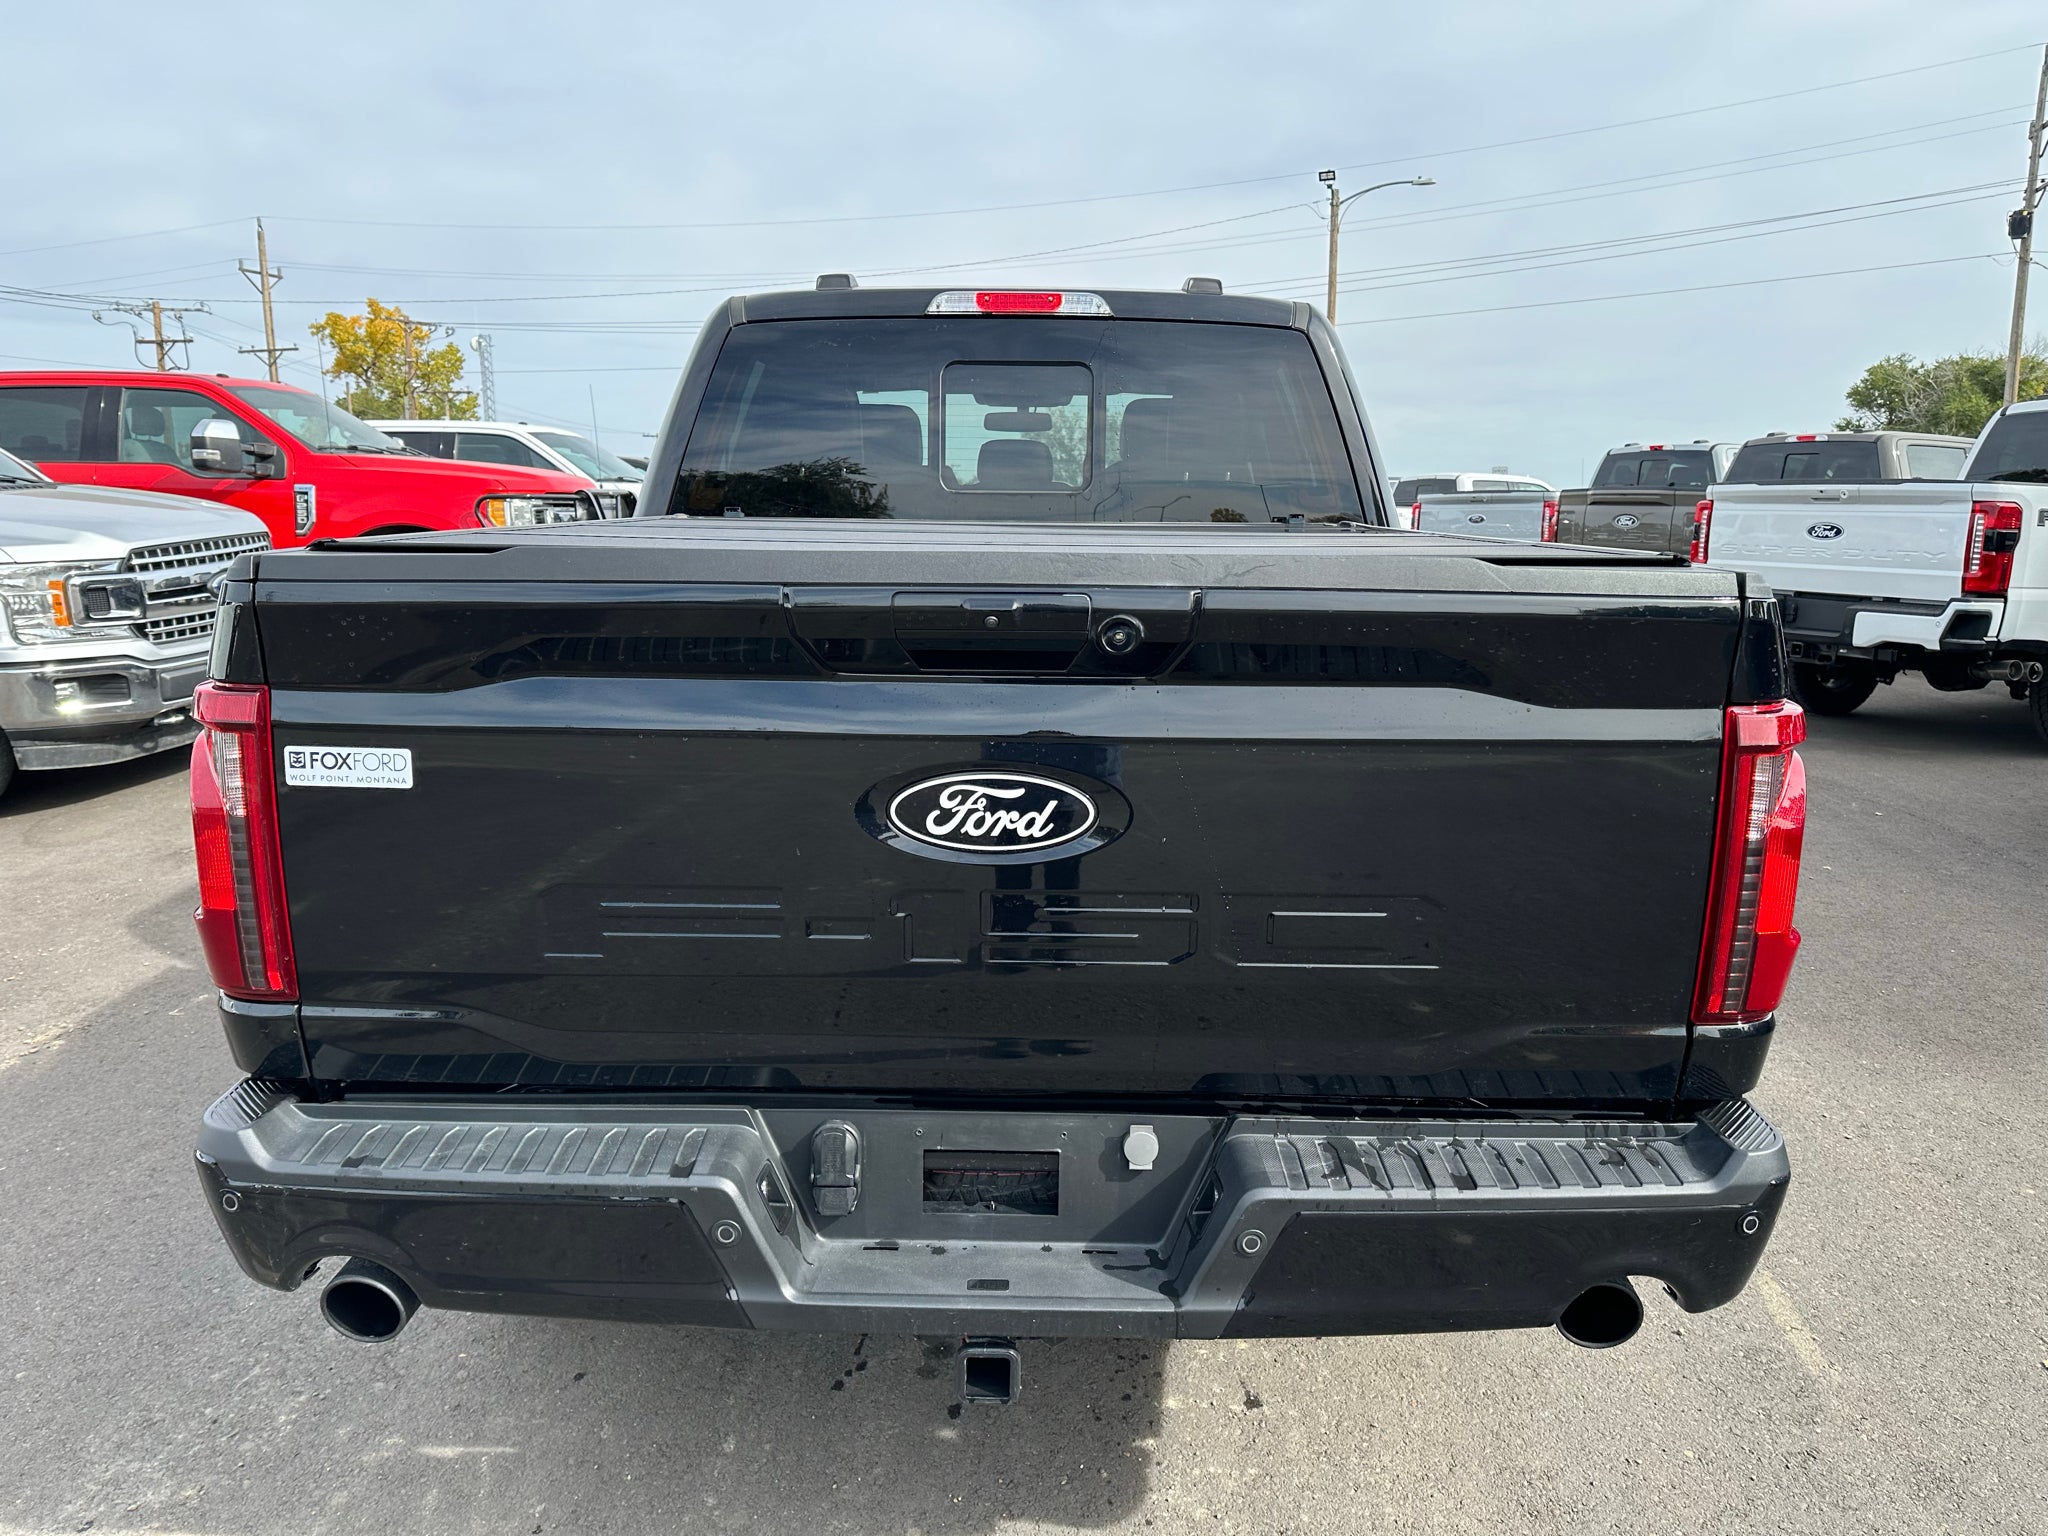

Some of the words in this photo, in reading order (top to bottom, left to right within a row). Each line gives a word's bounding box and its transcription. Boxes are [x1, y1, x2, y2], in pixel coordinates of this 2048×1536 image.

[1811, 525, 1837, 537] Ford
[290, 774, 317, 782] WOLF
[357, 776, 407, 785] MONTANA
[925, 784, 1058, 838] Ford
